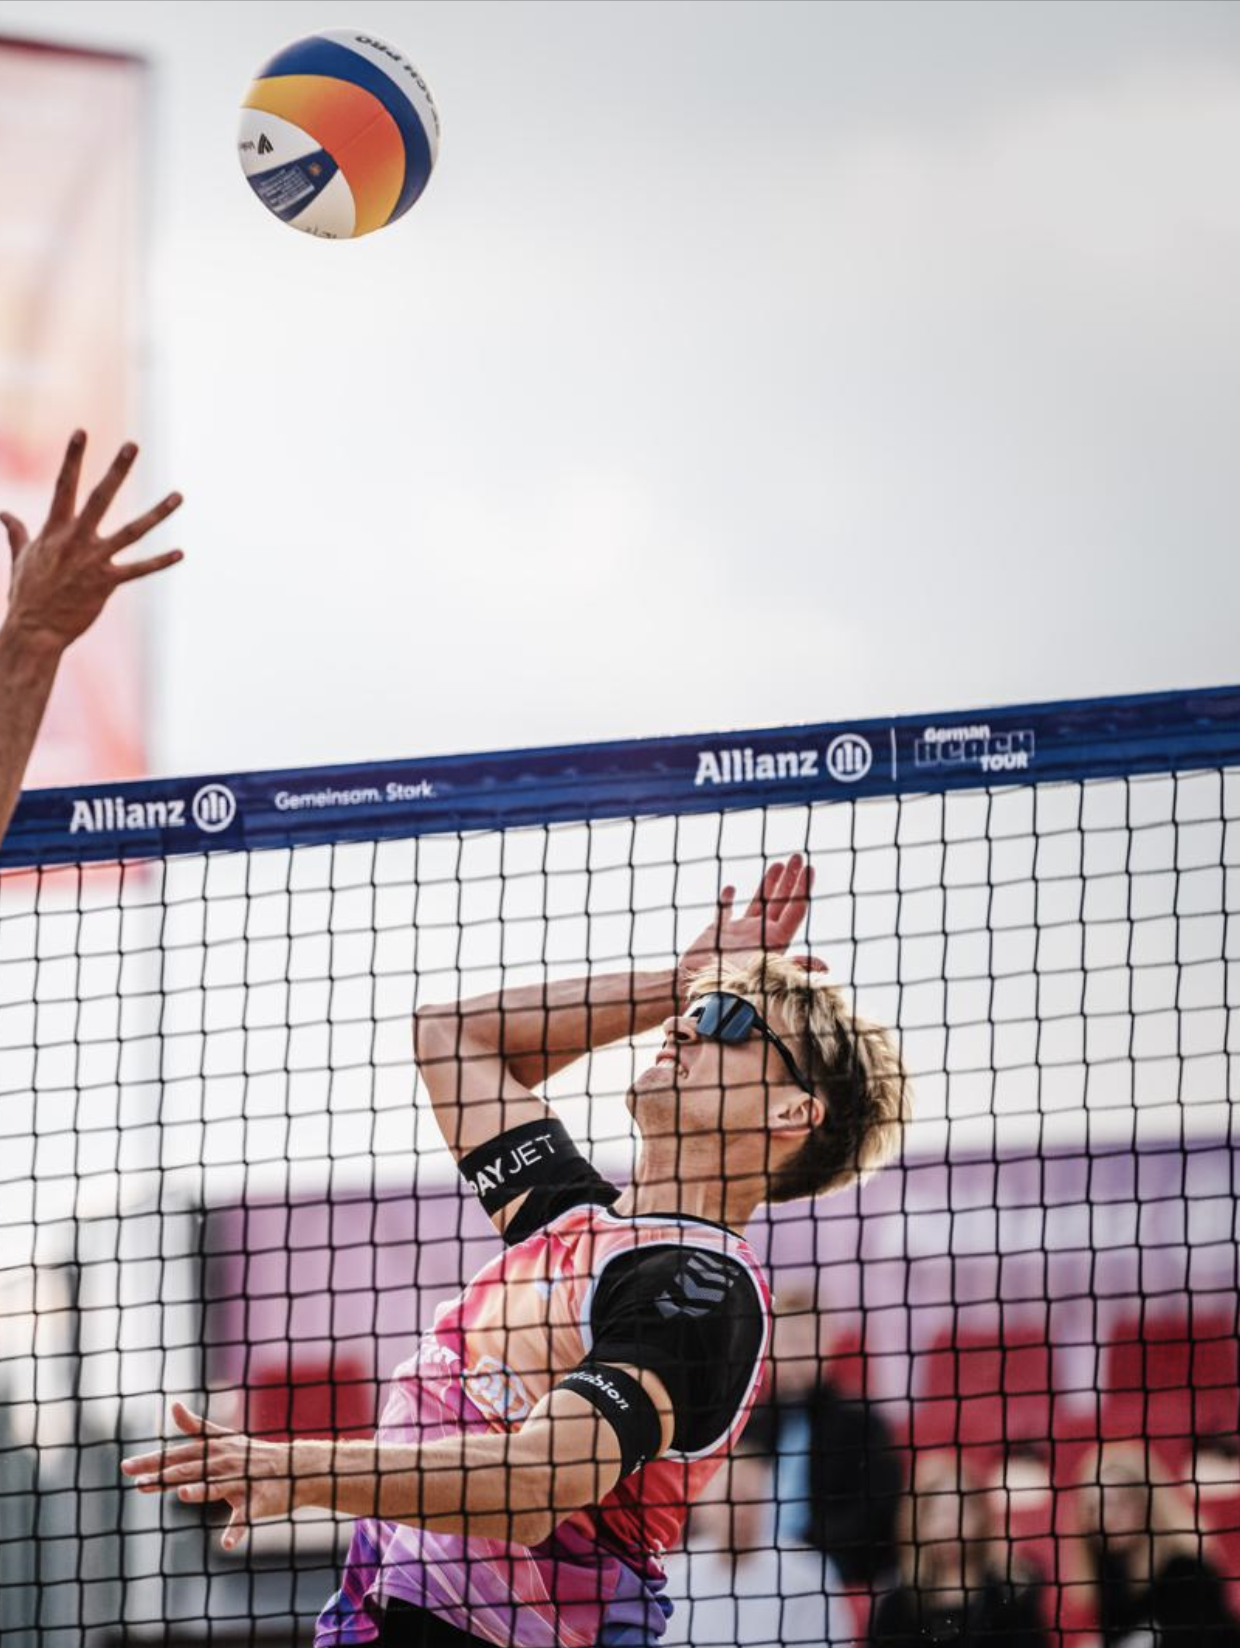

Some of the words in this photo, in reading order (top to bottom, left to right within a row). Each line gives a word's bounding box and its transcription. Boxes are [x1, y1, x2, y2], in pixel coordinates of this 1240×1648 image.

[924, 724, 991, 743] German
[694, 747, 819, 786] Allianz
[980, 750, 1028, 772] TOUR
[275, 787, 382, 811] Gemeinsam.
[386, 780, 436, 802] Stark.
[69, 797, 185, 834] Allianz
